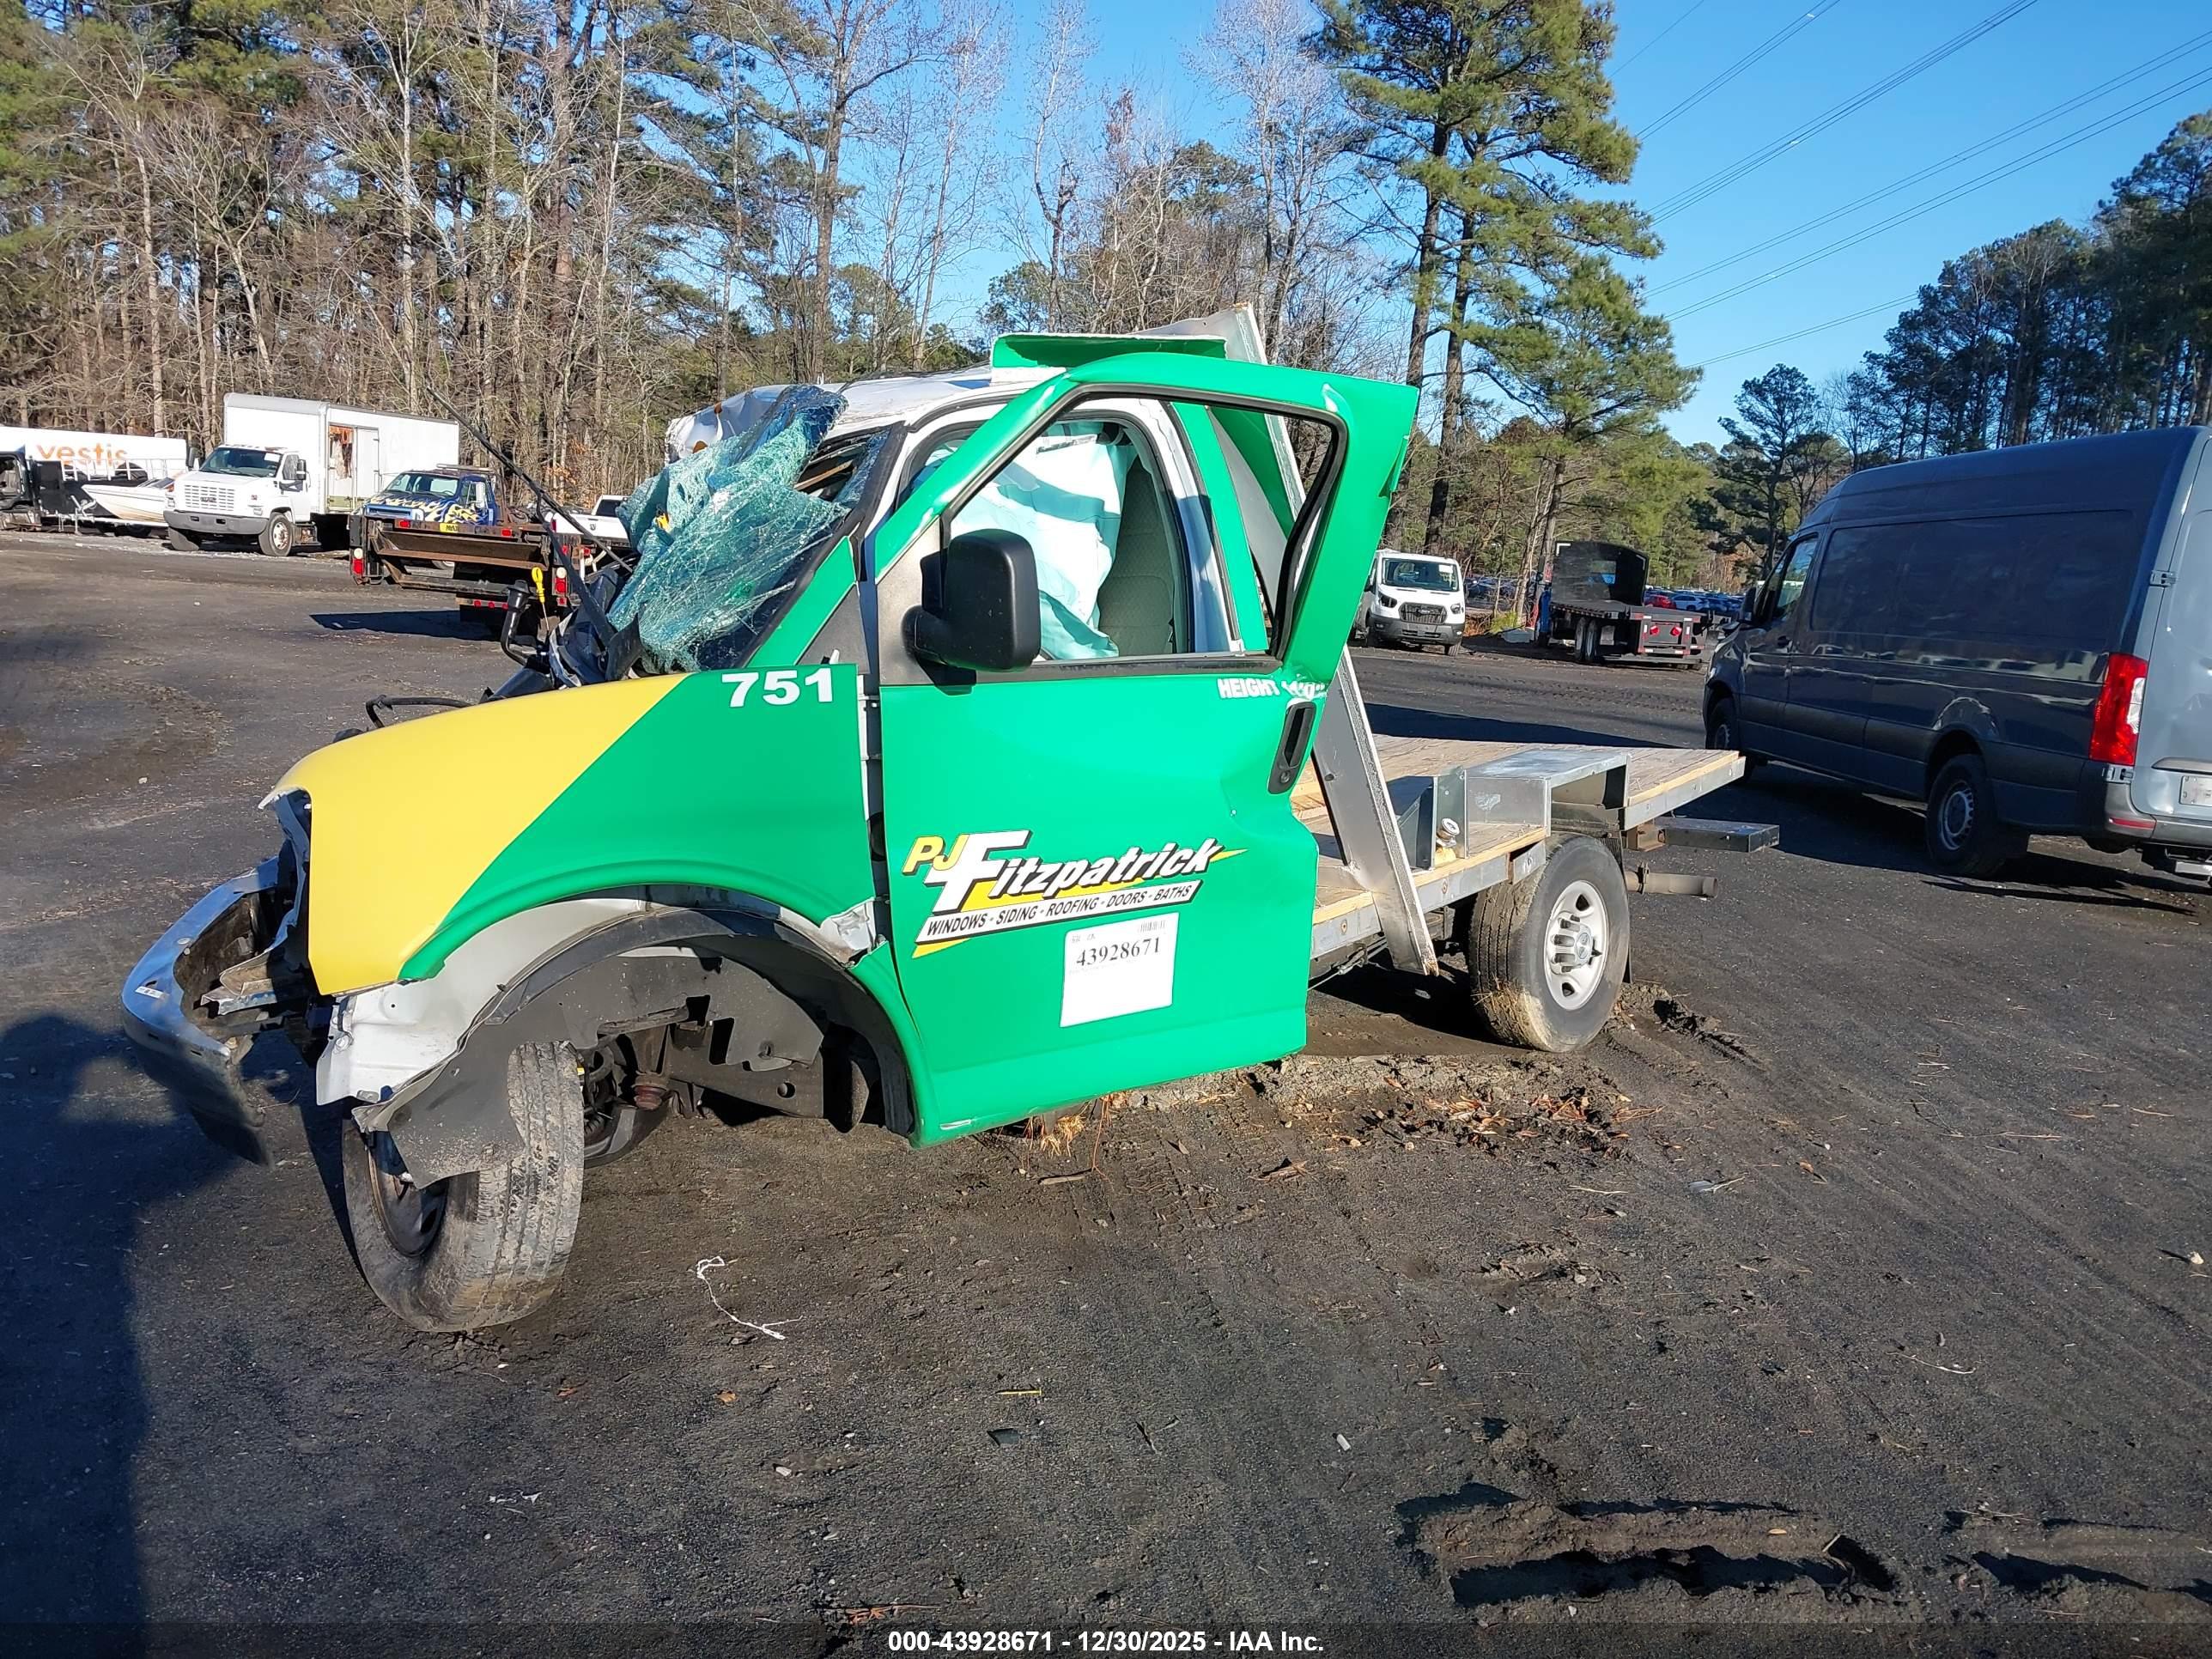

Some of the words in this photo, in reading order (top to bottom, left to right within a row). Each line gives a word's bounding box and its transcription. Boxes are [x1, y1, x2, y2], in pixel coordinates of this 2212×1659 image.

[37, 443, 128, 466] vestis
[721, 667, 833, 708] 751
[1218, 678, 1280, 699] HEIGHT
[902, 834, 969, 876] PJ
[923, 830, 1225, 915] Fitzpatrick
[927, 913, 988, 936] WINDOWS
[996, 905, 1038, 925] SIDING
[1046, 897, 1097, 918] ROOFING
[1106, 890, 1148, 908] DOORS
[1153, 884, 1193, 902] BATHS
[1075, 936, 1160, 967] 43928671
